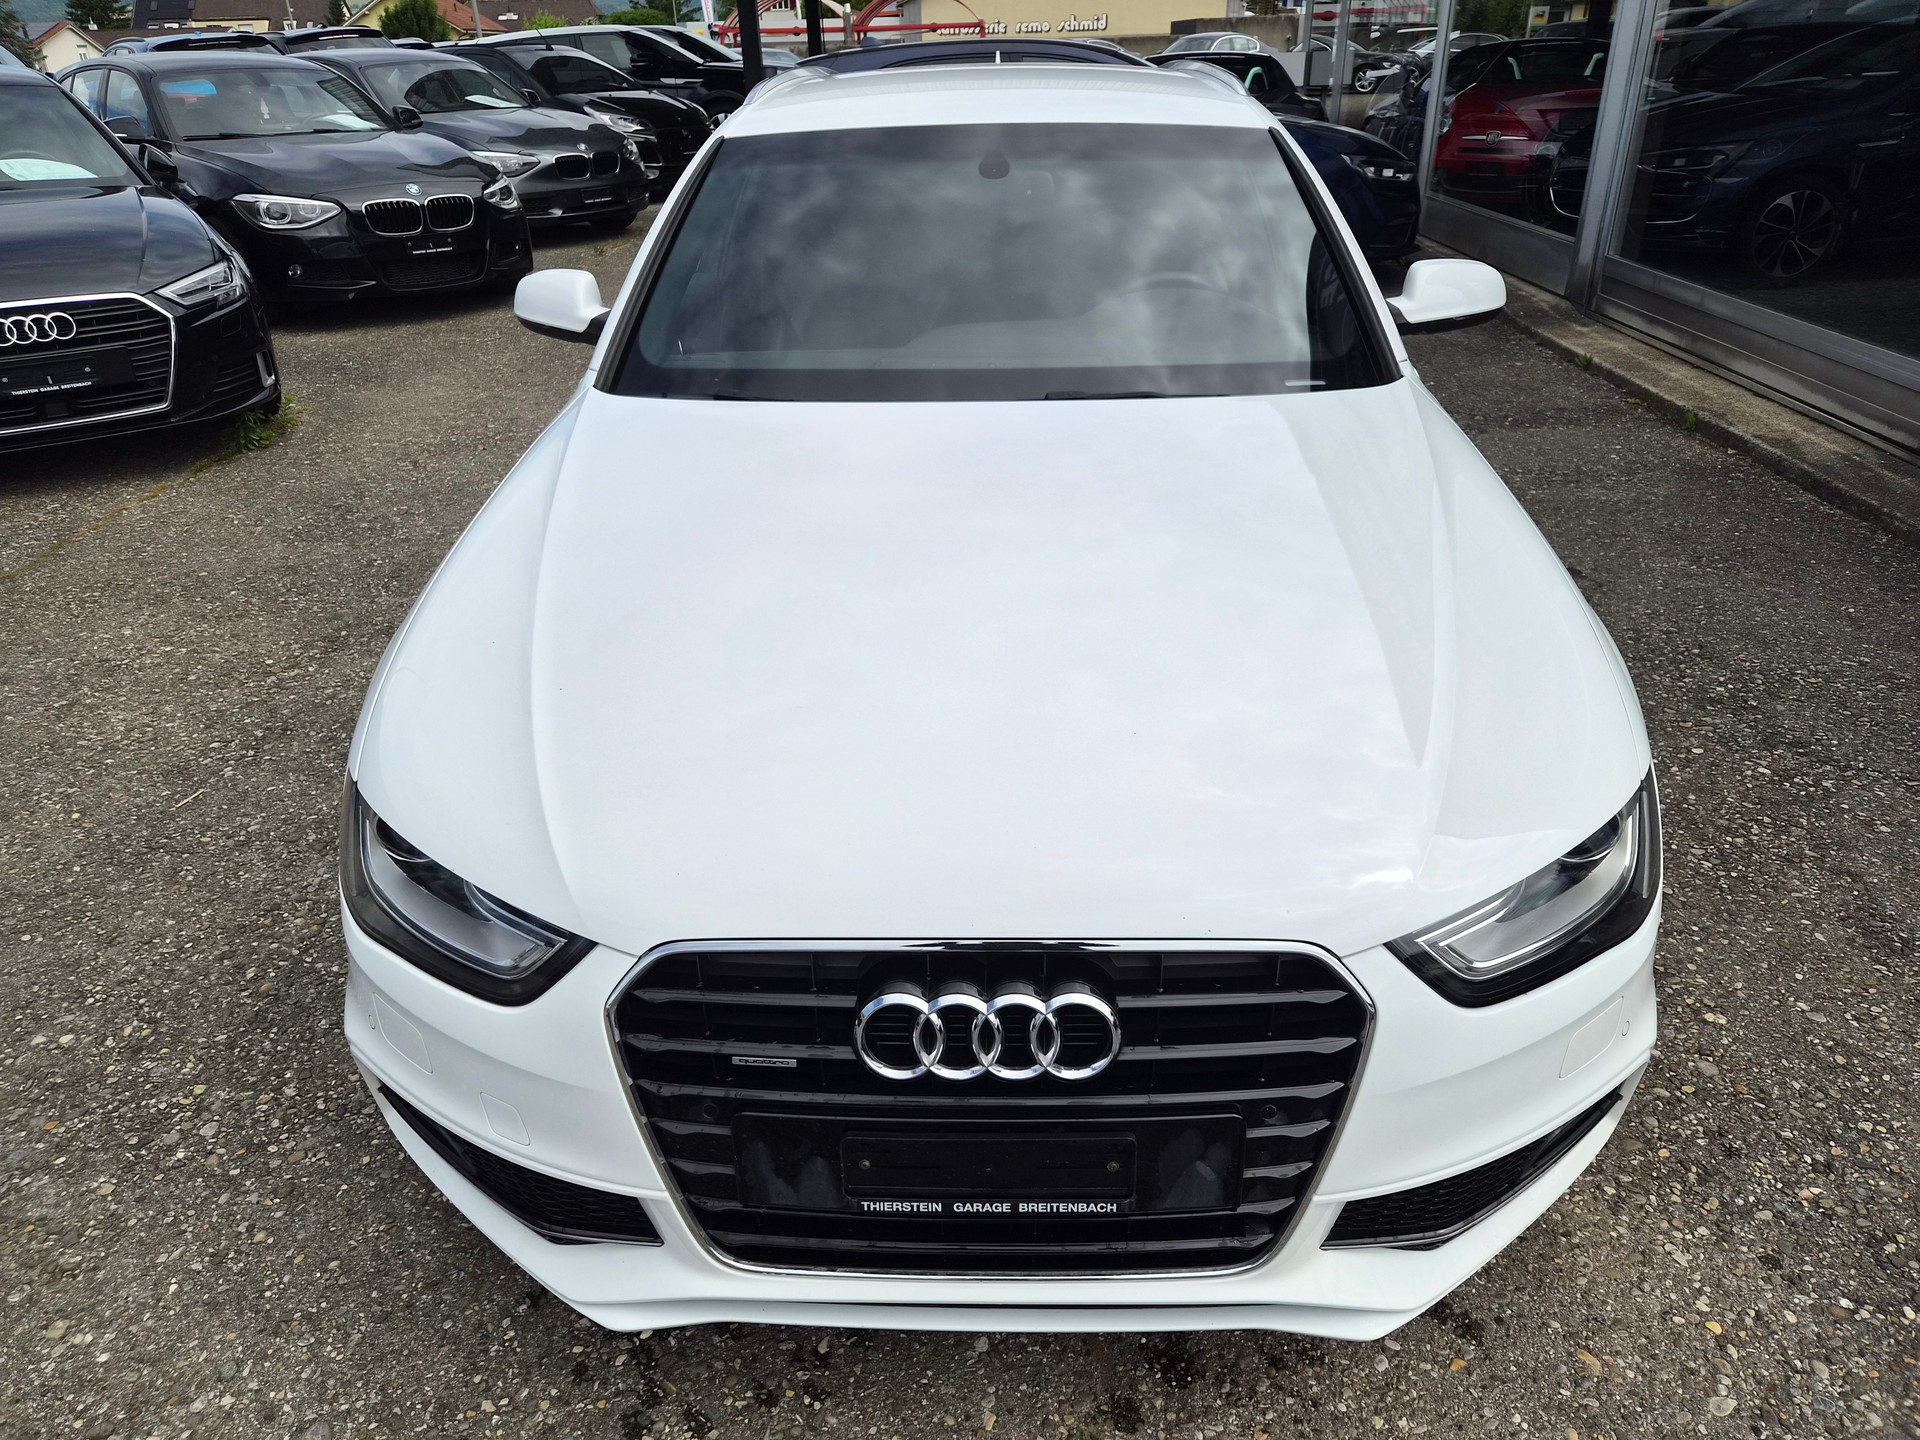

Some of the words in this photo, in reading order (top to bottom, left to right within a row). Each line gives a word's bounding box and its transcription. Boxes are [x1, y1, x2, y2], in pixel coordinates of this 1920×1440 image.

[1015, 21, 1051, 34] remo
[1057, 13, 1108, 32] schmid
[737, 1058, 791, 1066] quattro
[861, 1201, 942, 1212] THIERSTEIN
[953, 1202, 1012, 1213] GARAGE
[1018, 1202, 1117, 1213] BREITENBACH
